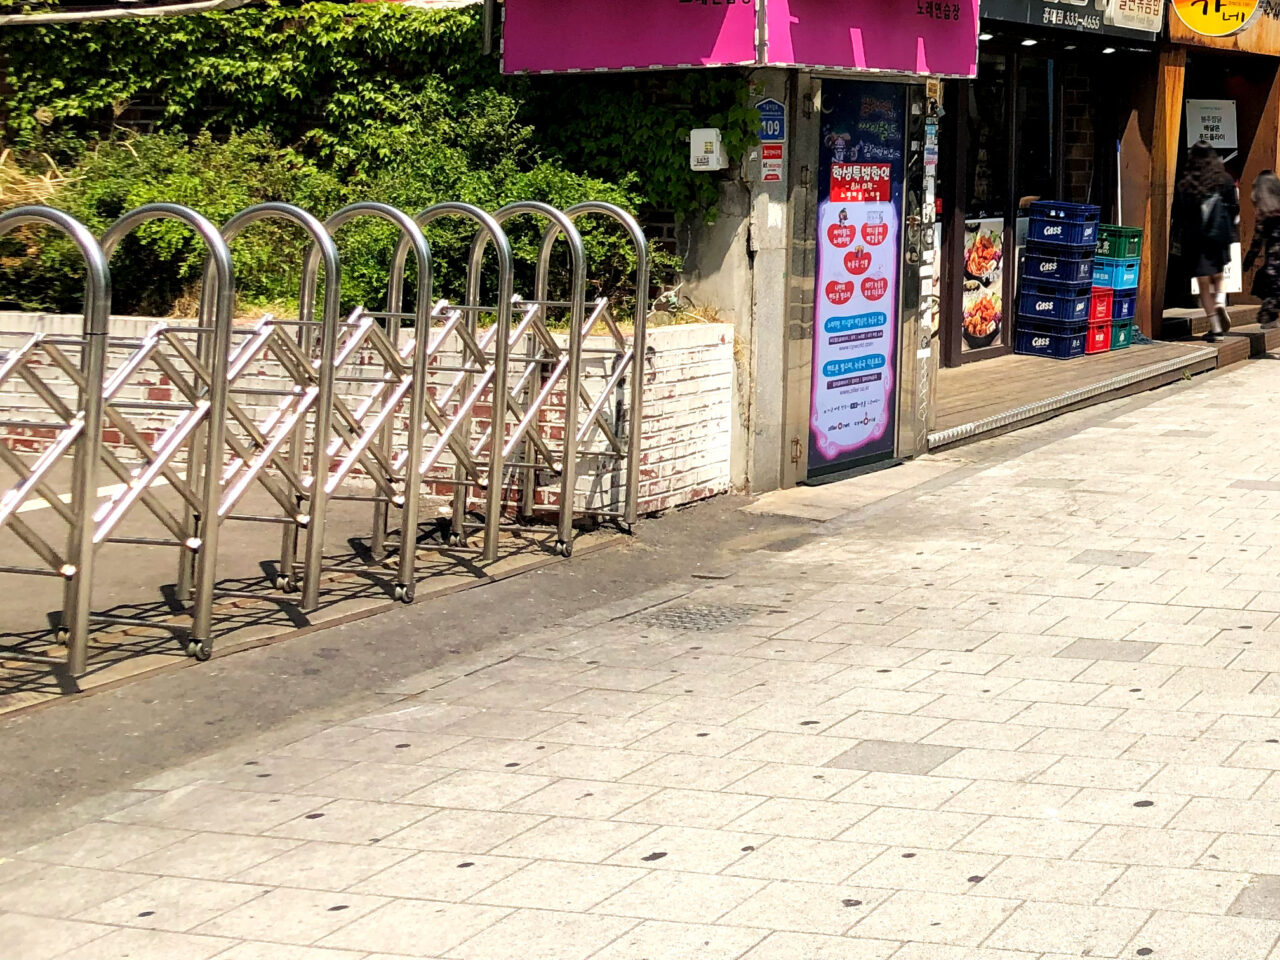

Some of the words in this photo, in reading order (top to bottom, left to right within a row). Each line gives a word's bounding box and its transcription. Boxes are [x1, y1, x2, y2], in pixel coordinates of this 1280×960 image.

[916, 0, 961, 22] 노래연습장
[1043, 7, 1064, 24] 홍대점
[1065, 11, 1100, 29] 333-4655
[761, 121, 780, 135] 109
[832, 166, 890, 180] 학생특별할인
[1044, 226, 1062, 235] Cass
[1040, 262, 1057, 271] Cass
[1036, 301, 1053, 311] Cass
[1032, 337, 1050, 346] Cass
